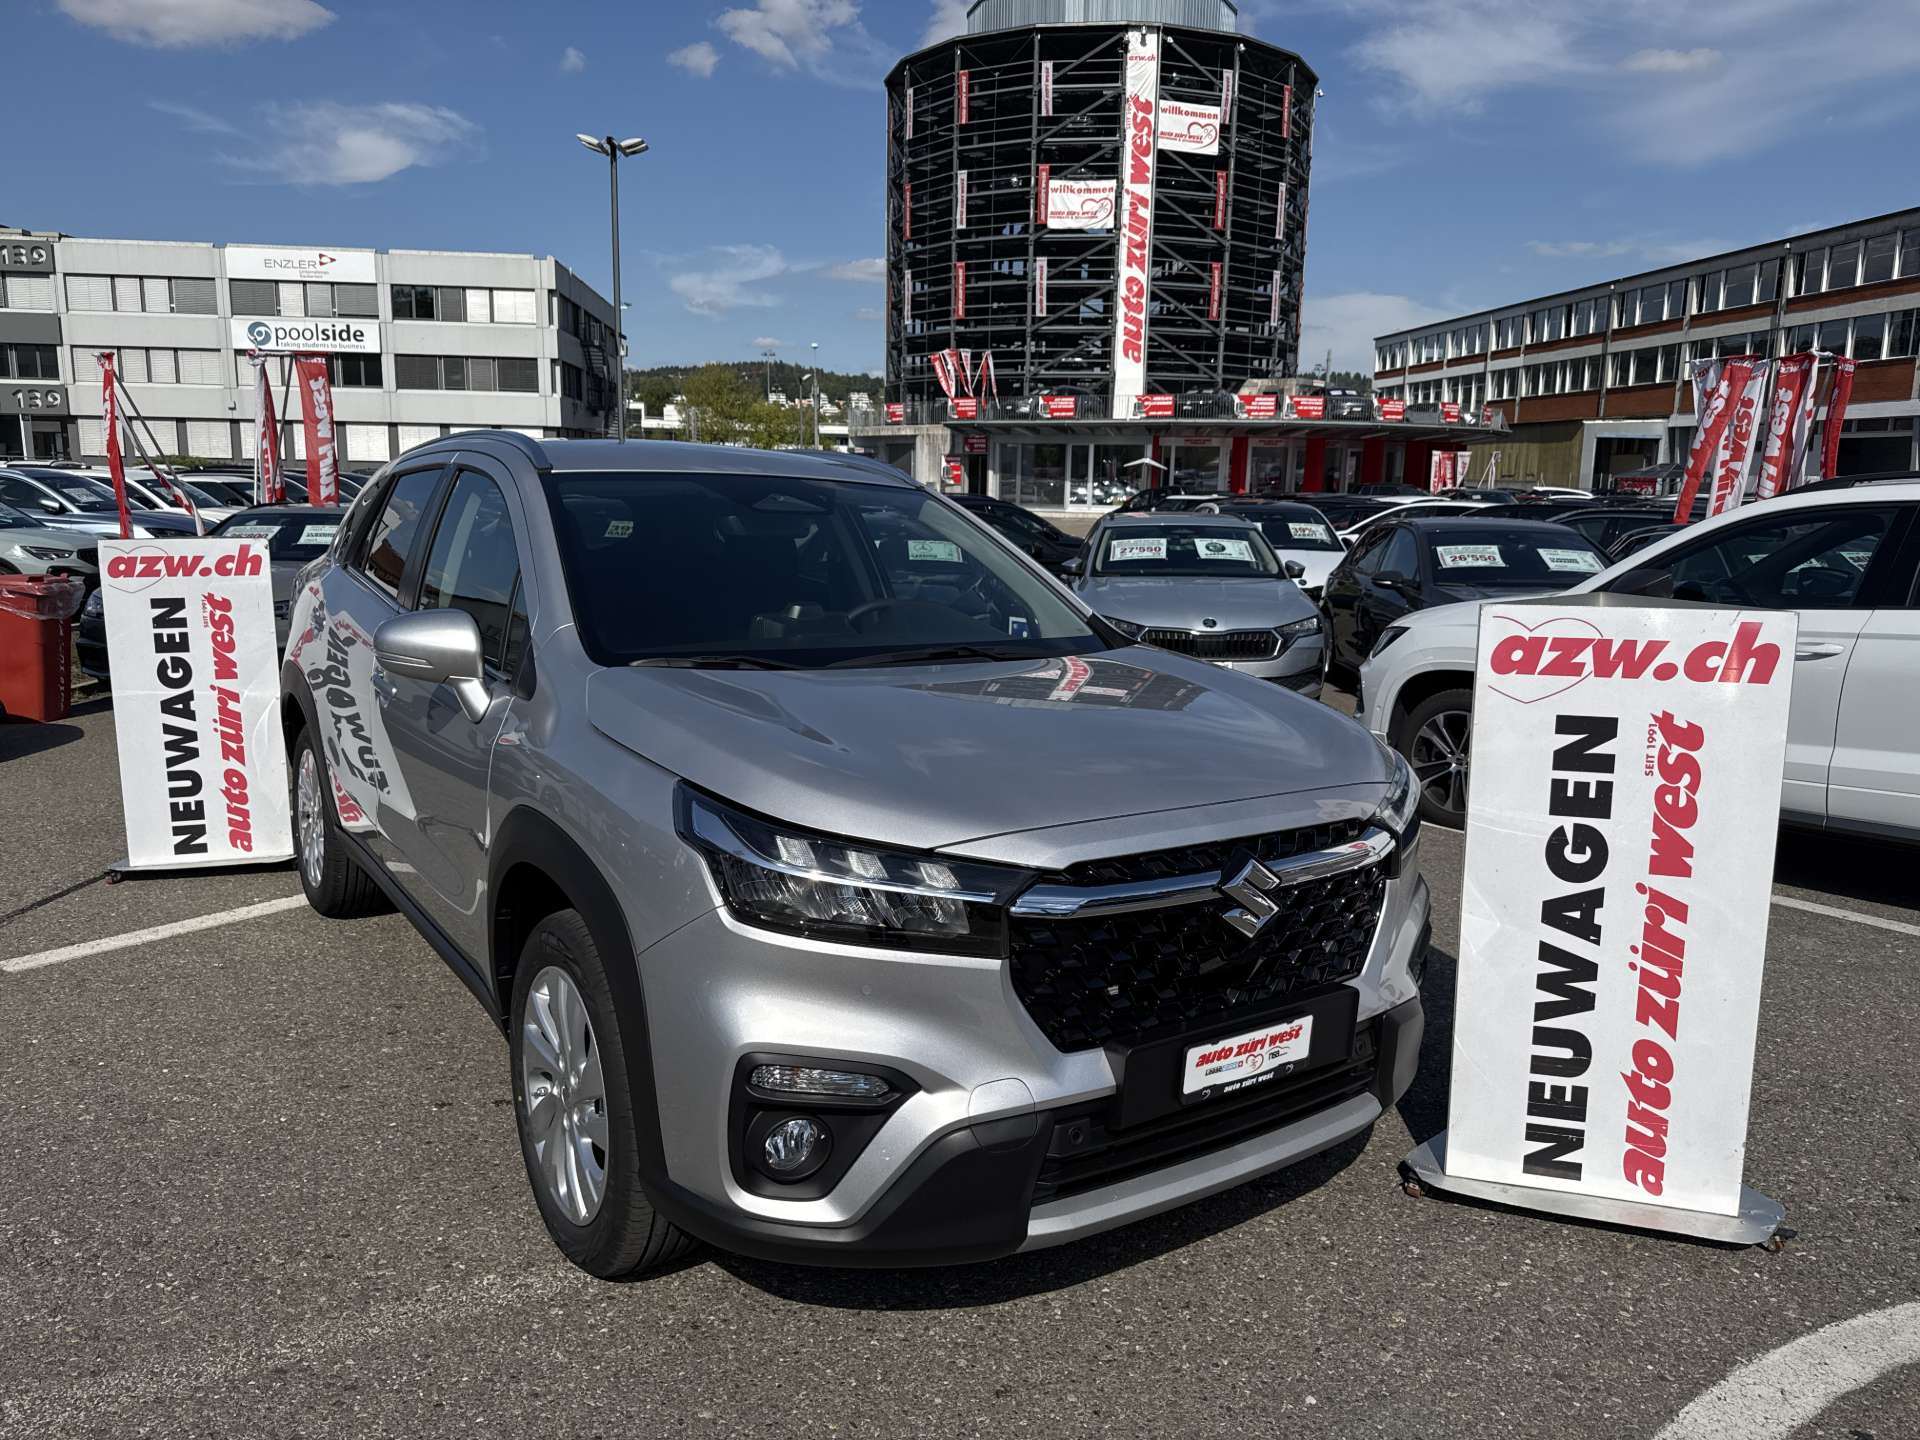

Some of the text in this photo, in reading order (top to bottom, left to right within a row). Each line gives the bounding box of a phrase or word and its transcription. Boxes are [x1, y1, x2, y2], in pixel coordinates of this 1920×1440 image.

[1160, 105, 1218, 120] willkommen
[1050, 184, 1114, 195] willkommen
[1120, 93, 1153, 364] auto züri west
[1, 245, 47, 265] 139
[264, 258, 318, 270] ENZLER
[275, 323, 364, 347] poolside
[339, 342, 366, 350] business
[12, 388, 61, 409] 139
[1764, 387, 1793, 457] west
[107, 544, 262, 578] azw.ch
[1490, 621, 1781, 684] azw.ch
[150, 597, 208, 855] NEUWAGEN
[202, 592, 253, 853] auto züri west
[1645, 722, 1658, 777] SEIT 1991
[1523, 714, 1618, 1181] NEUWAGEN
[1619, 710, 1705, 1197] auto züri west
[1195, 1024, 1303, 1068] auto züri west
